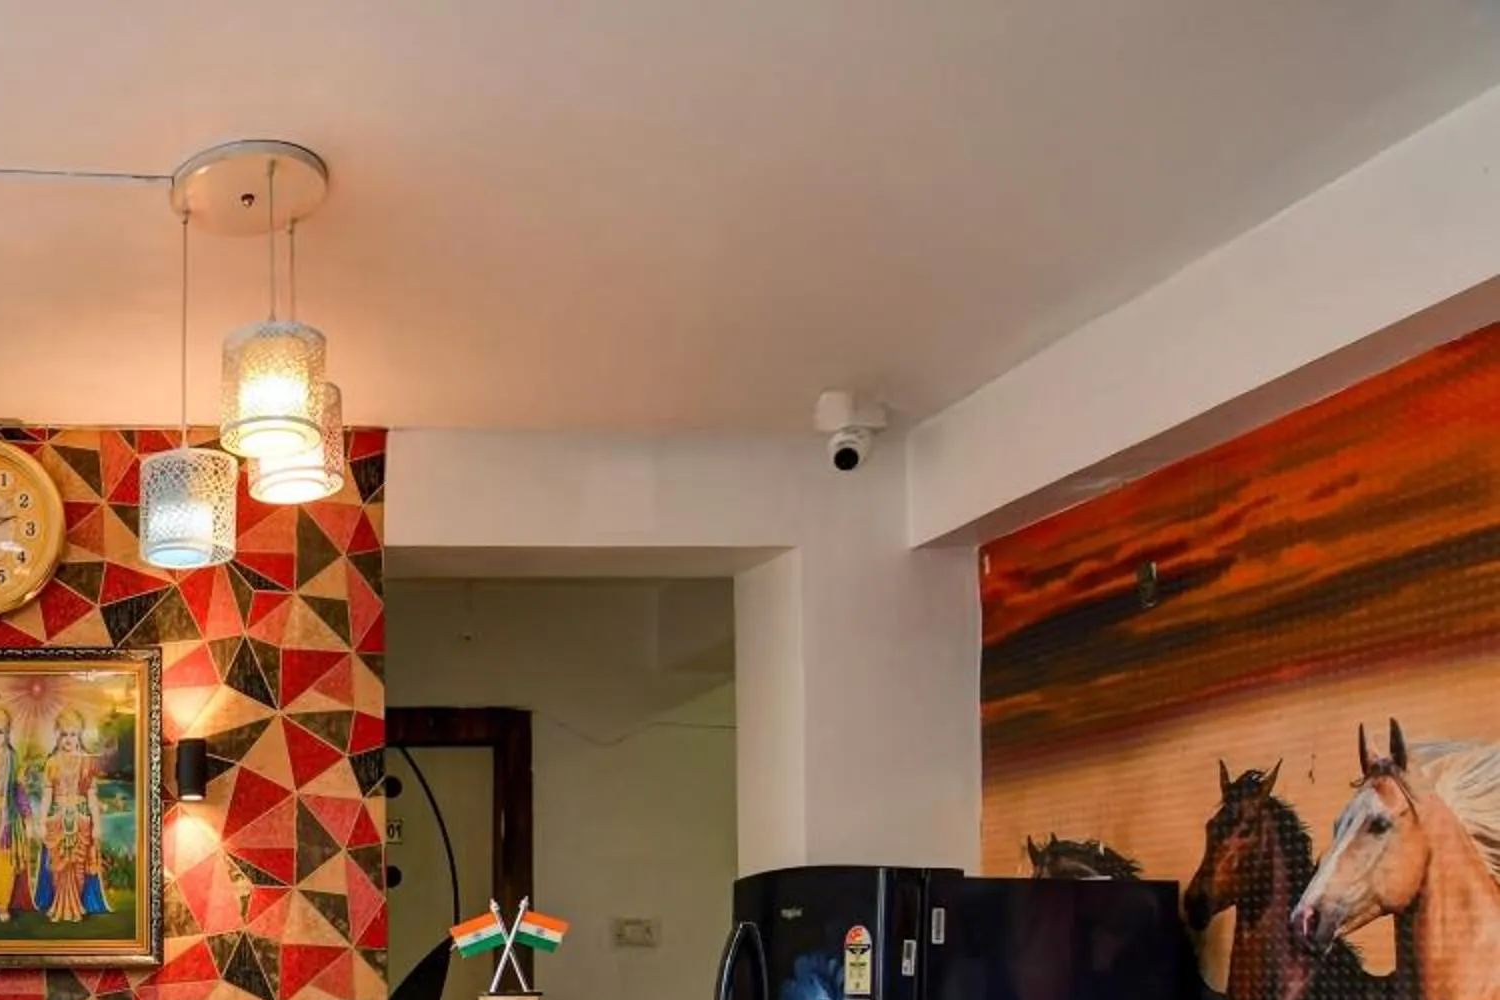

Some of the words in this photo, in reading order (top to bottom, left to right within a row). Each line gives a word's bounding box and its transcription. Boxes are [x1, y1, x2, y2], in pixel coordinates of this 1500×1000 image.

[0, 473, 7, 487] 1
[19, 493, 29, 508] 2
[25, 522, 35, 537] 3
[17, 550, 26, 563] 4
